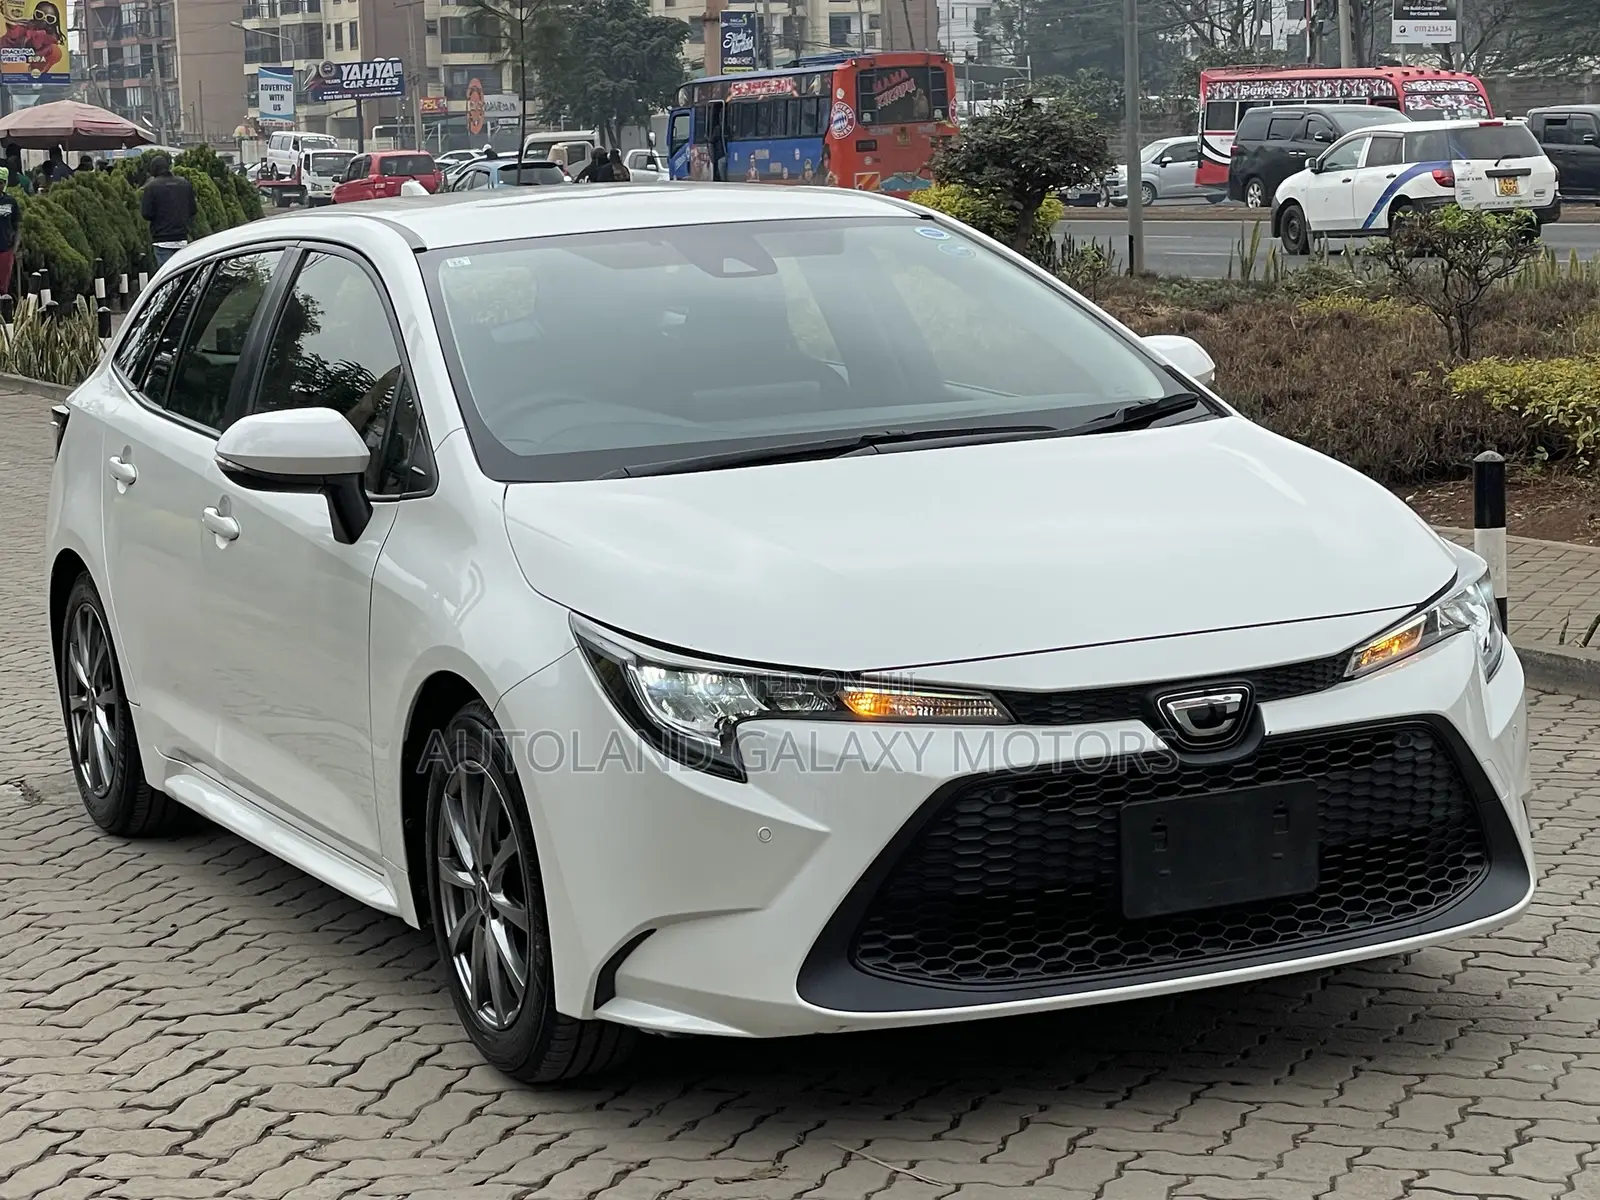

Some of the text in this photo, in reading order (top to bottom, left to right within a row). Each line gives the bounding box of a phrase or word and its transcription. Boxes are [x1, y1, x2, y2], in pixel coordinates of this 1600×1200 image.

[341, 62, 394, 80] YAHYA
[343, 78, 399, 88] CAR SALES
[1240, 85, 1291, 96] Remedy
